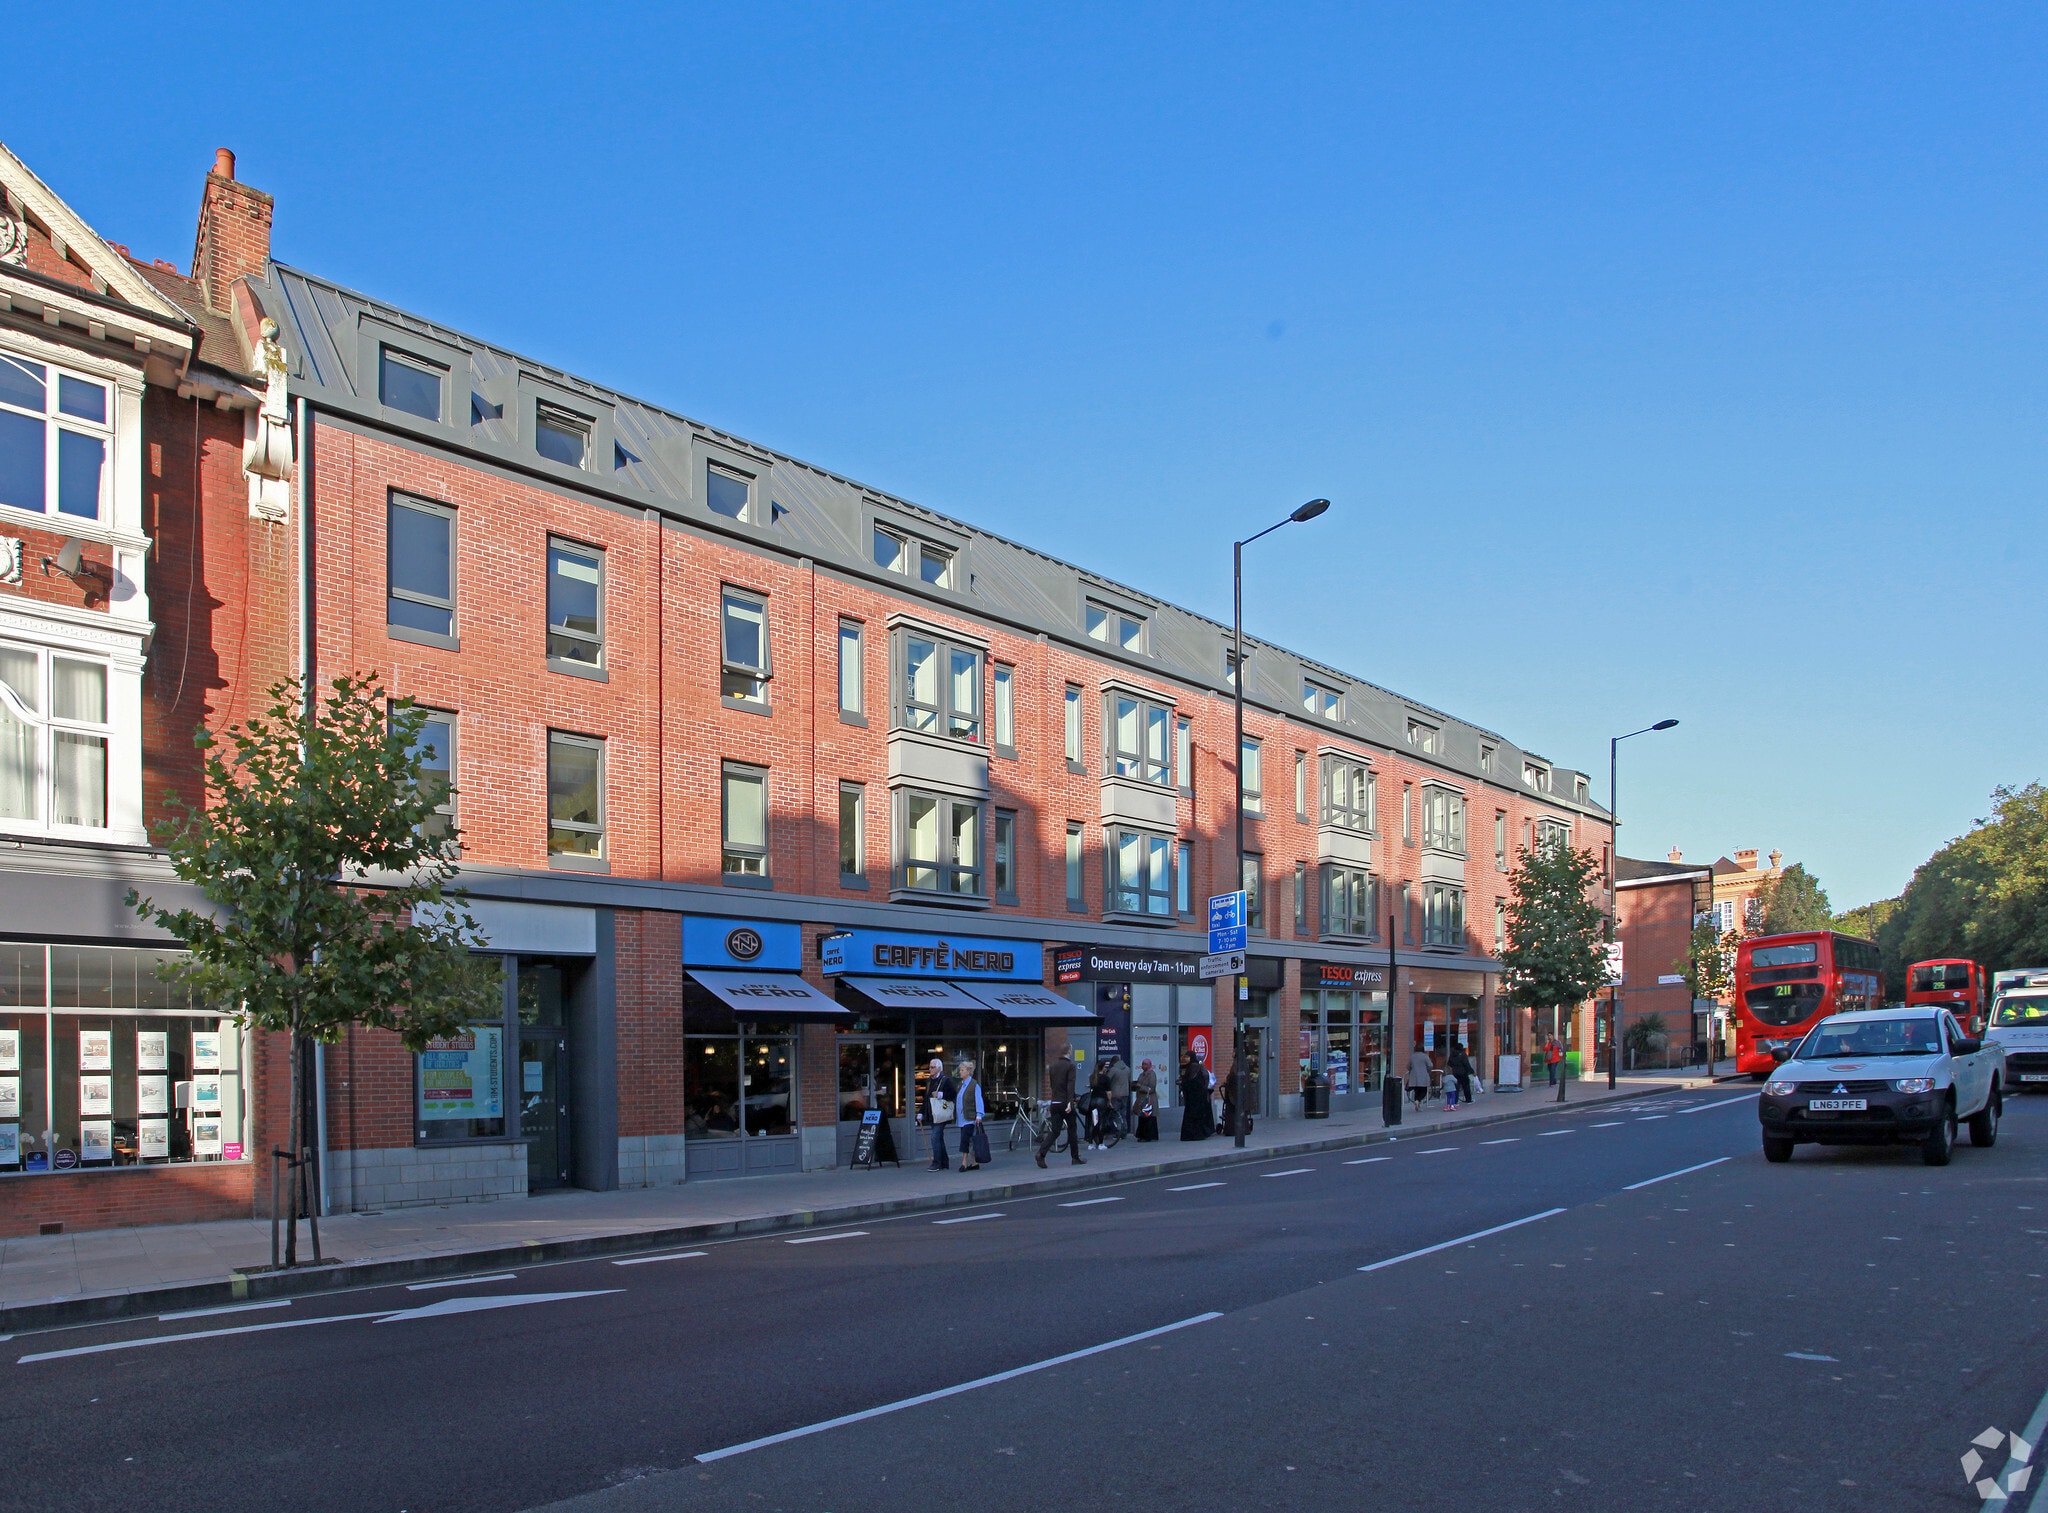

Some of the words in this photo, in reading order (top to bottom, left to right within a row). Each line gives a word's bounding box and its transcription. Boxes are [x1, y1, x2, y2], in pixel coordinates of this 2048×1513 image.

[952, 948, 1014, 972] NERO
[1057, 950, 1082, 960] TESCO
[823, 955, 843, 967] NERO
[1058, 961, 1081, 972] express
[1090, 956, 1114, 971] Open
[1115, 961, 1137, 973] every
[1138, 959, 1152, 974] day
[1153, 960, 1170, 972] 7am
[1175, 962, 1195, 975] 11pm
[1201, 961, 1229, 970] enforcement
[1205, 968, 1224, 976] cameras
[1320, 965, 1352, 980] TESCO
[1354, 969, 1382, 985] express
[1776, 985, 1791, 996] 211
[1933, 981, 1946, 990] 295
[725, 987, 812, 998] NERO
[878, 987, 949, 998] NERO
[995, 997, 1057, 1006] NERO
[425, 1041, 450, 1049] STUDENT
[451, 1041, 474, 1049] STUDIOS
[1813, 1100, 1839, 1109] LN63
[1841, 1100, 1862, 1109] PFE
